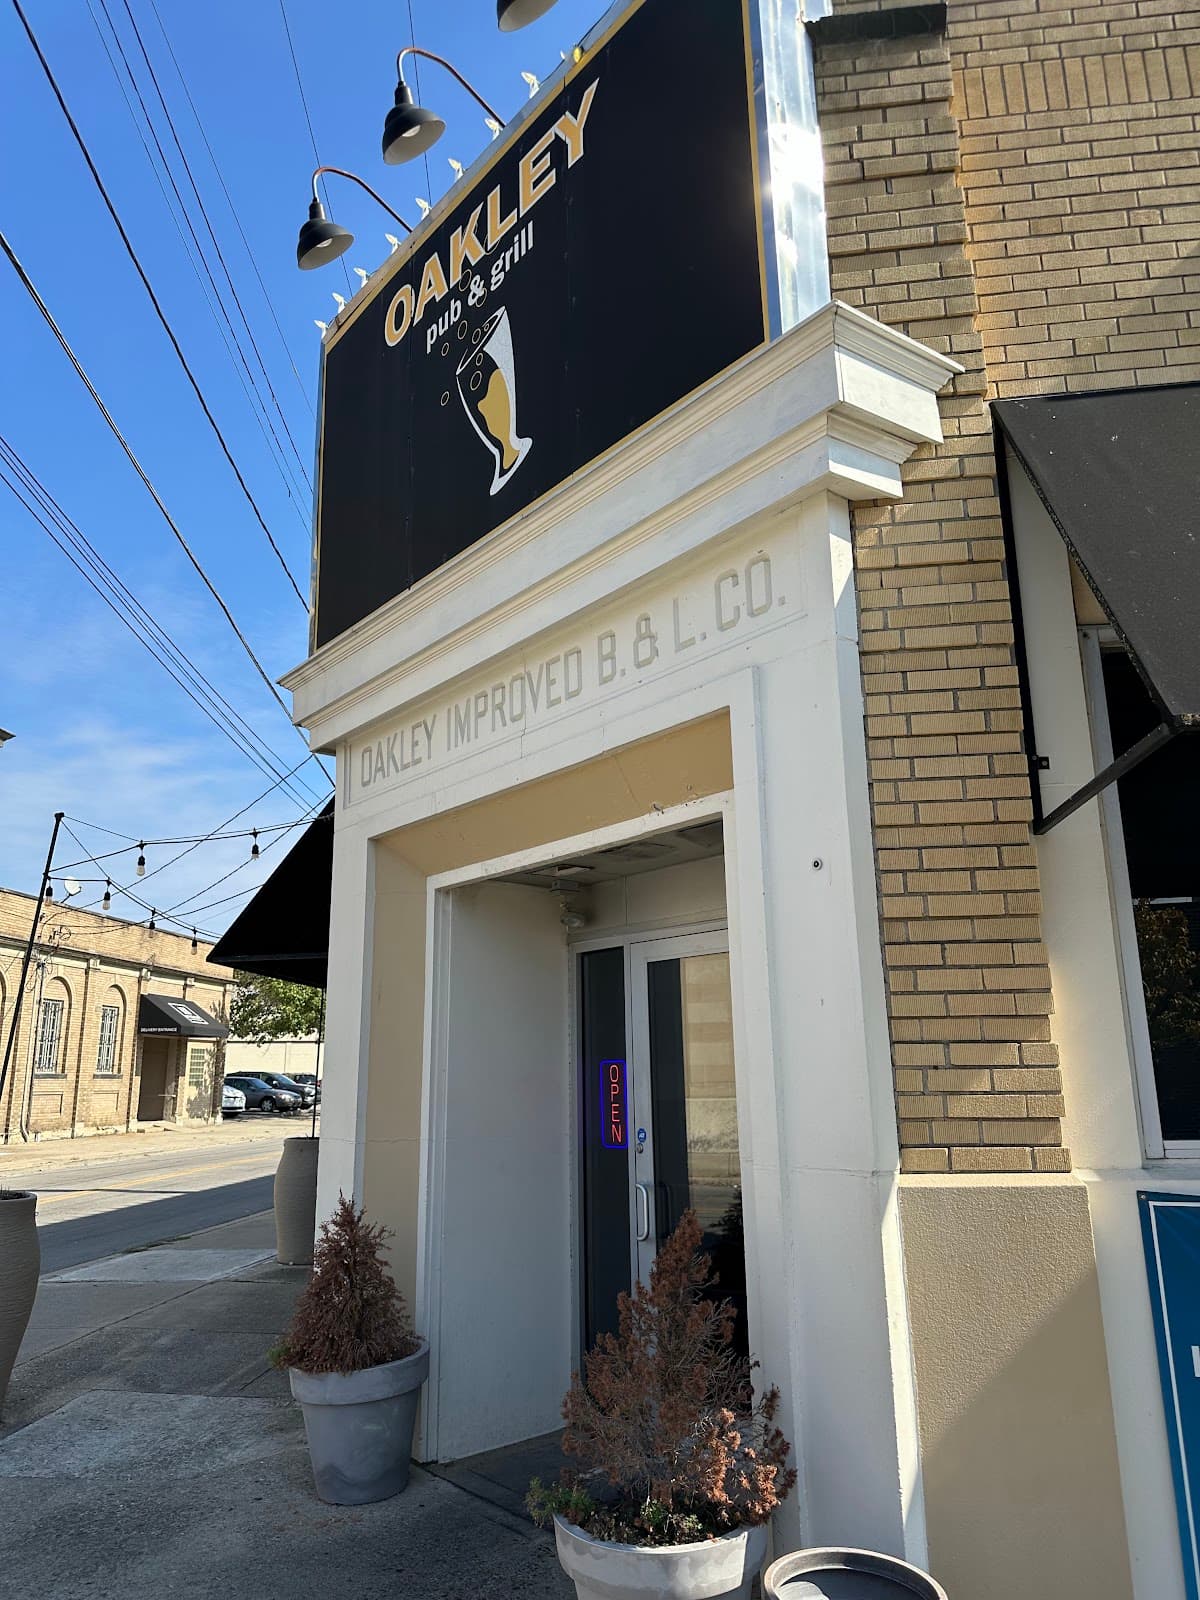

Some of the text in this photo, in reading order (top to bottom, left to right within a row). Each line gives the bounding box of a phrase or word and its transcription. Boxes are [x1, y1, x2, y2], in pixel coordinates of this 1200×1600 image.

[384, 77, 600, 347] OAKLEY
[426, 219, 534, 355] pub & grill
[360, 713, 437, 788] OAKLEY
[446, 646, 583, 752] IMPROVED
[597, 628, 627, 687] B.
[632, 611, 660, 670] &
[713, 551, 787, 633] CO.
[609, 1064, 622, 1144] OPEN
